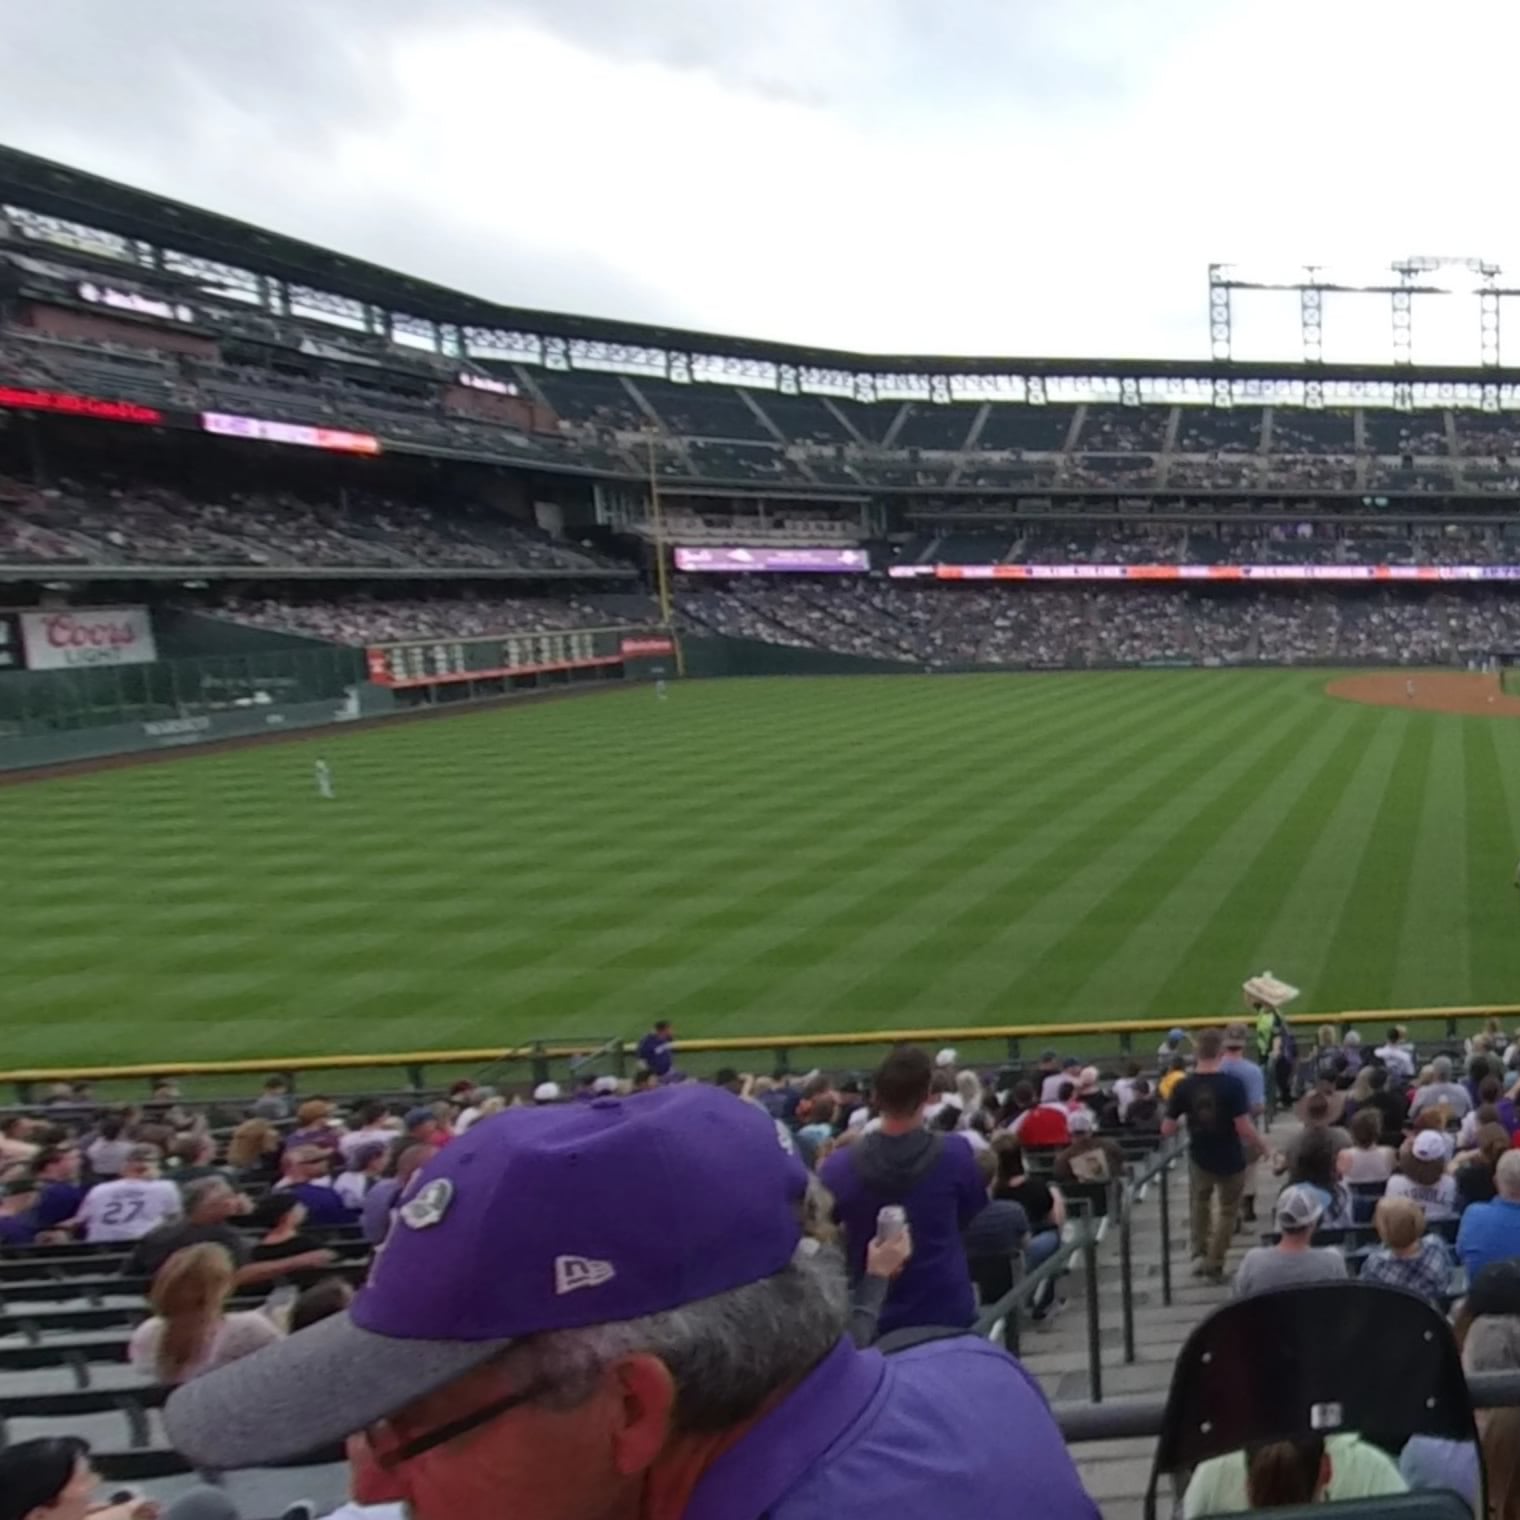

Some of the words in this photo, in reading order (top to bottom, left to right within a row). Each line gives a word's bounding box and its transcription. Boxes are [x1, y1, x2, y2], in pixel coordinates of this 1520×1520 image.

[40, 613, 135, 648] Coors
[64, 645, 121, 665] LIGHT
[102, 1200, 146, 1226] 27
